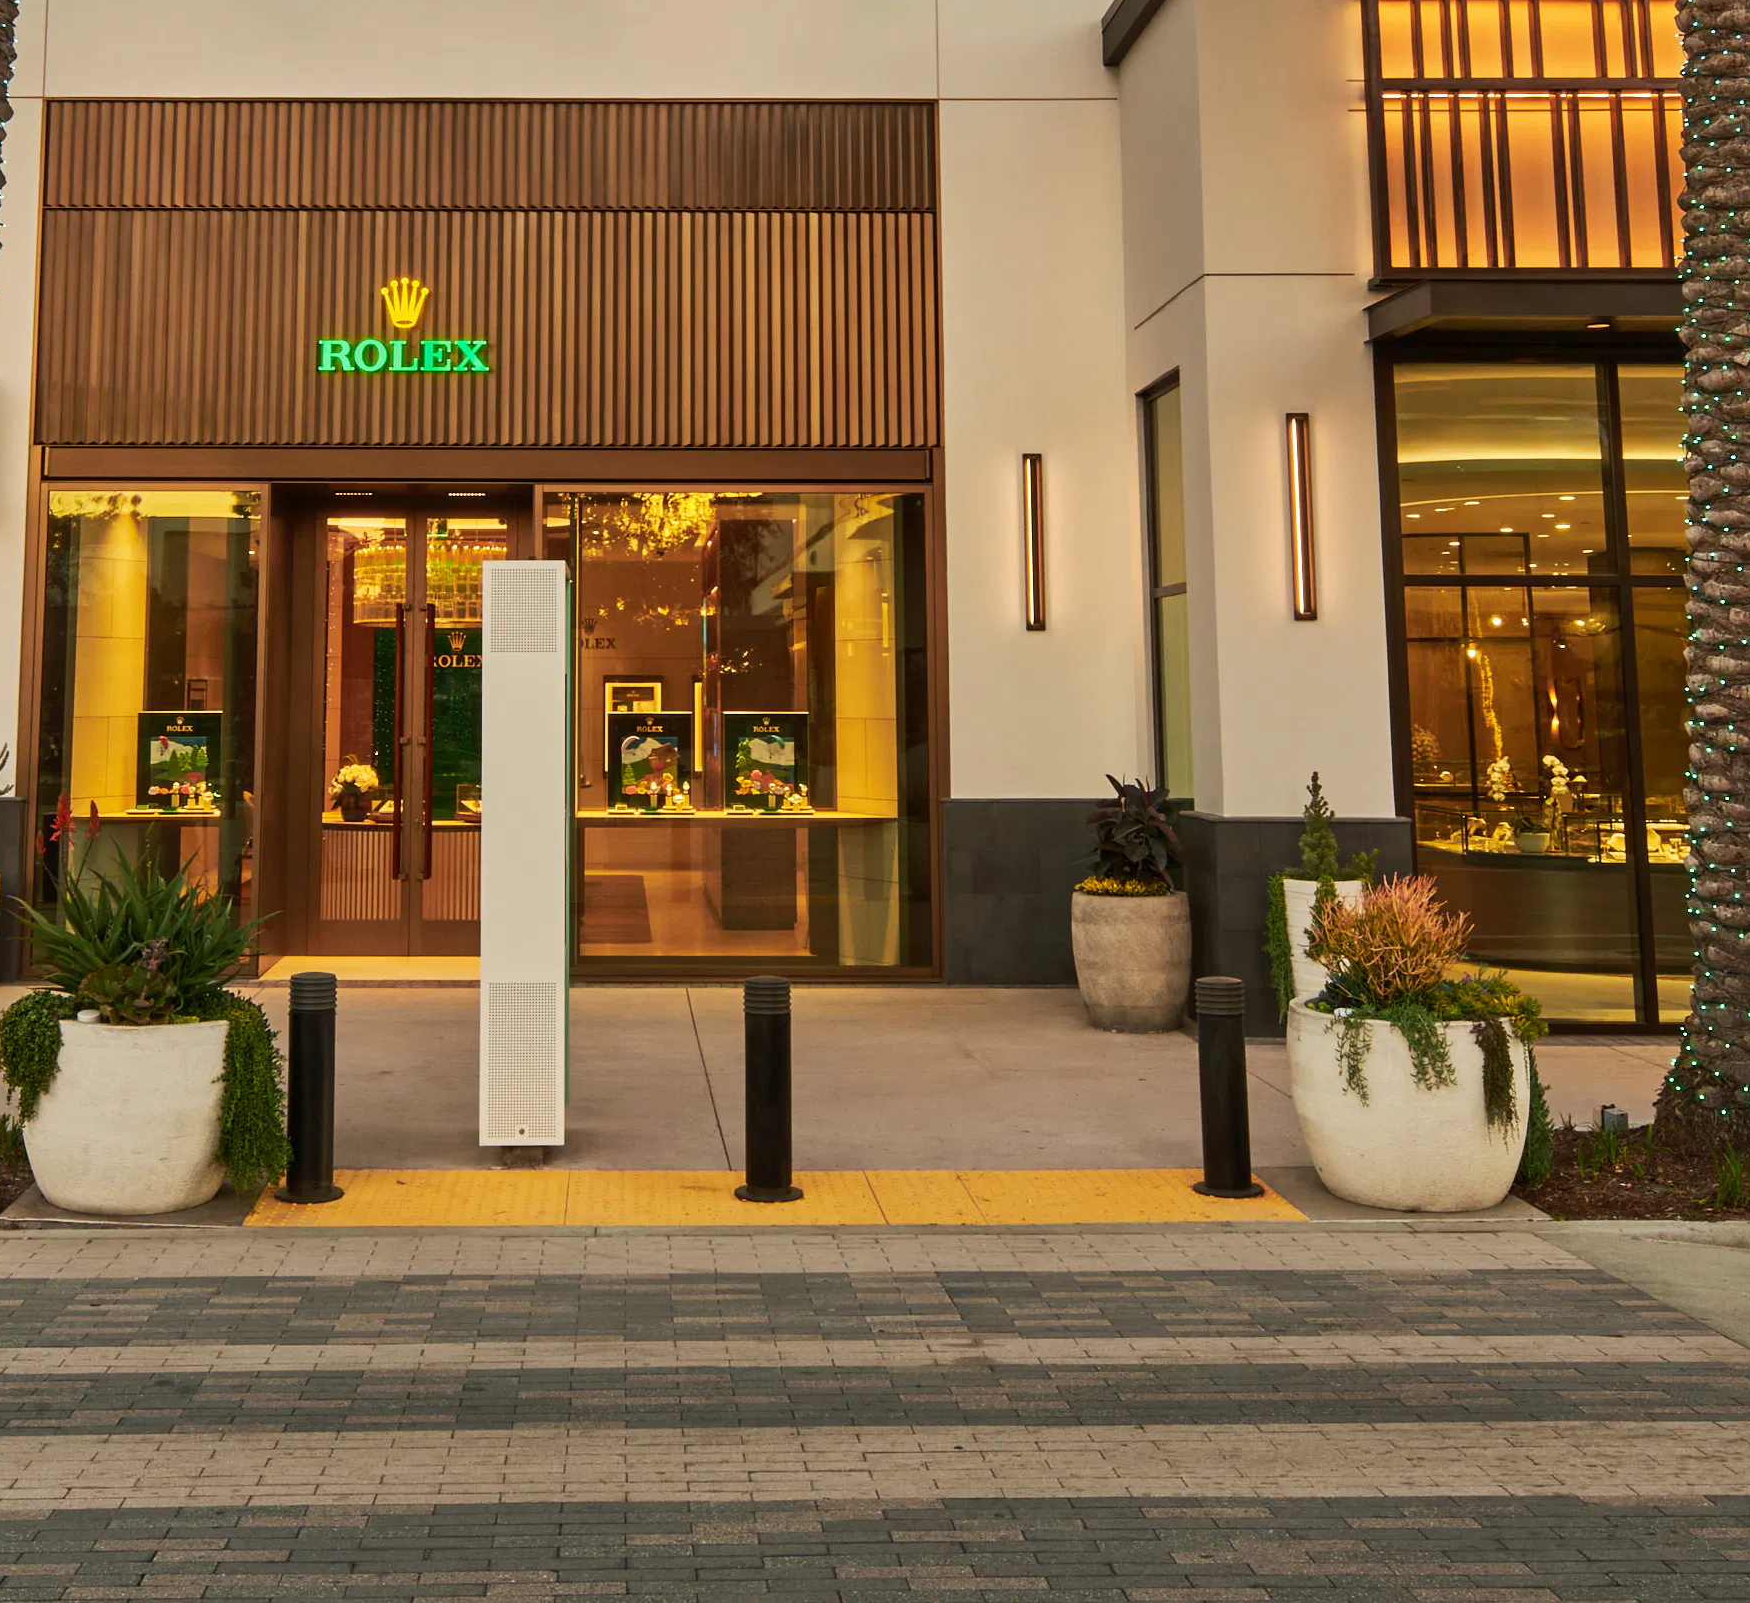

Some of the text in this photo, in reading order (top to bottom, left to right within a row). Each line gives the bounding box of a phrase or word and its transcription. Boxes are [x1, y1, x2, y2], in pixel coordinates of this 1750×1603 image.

[317, 338, 490, 372] ROLEX
[580, 637, 617, 649] LEX
[434, 654, 482, 668] OLE
[636, 725, 663, 733] ROLEX
[753, 725, 780, 733] ROLEX
